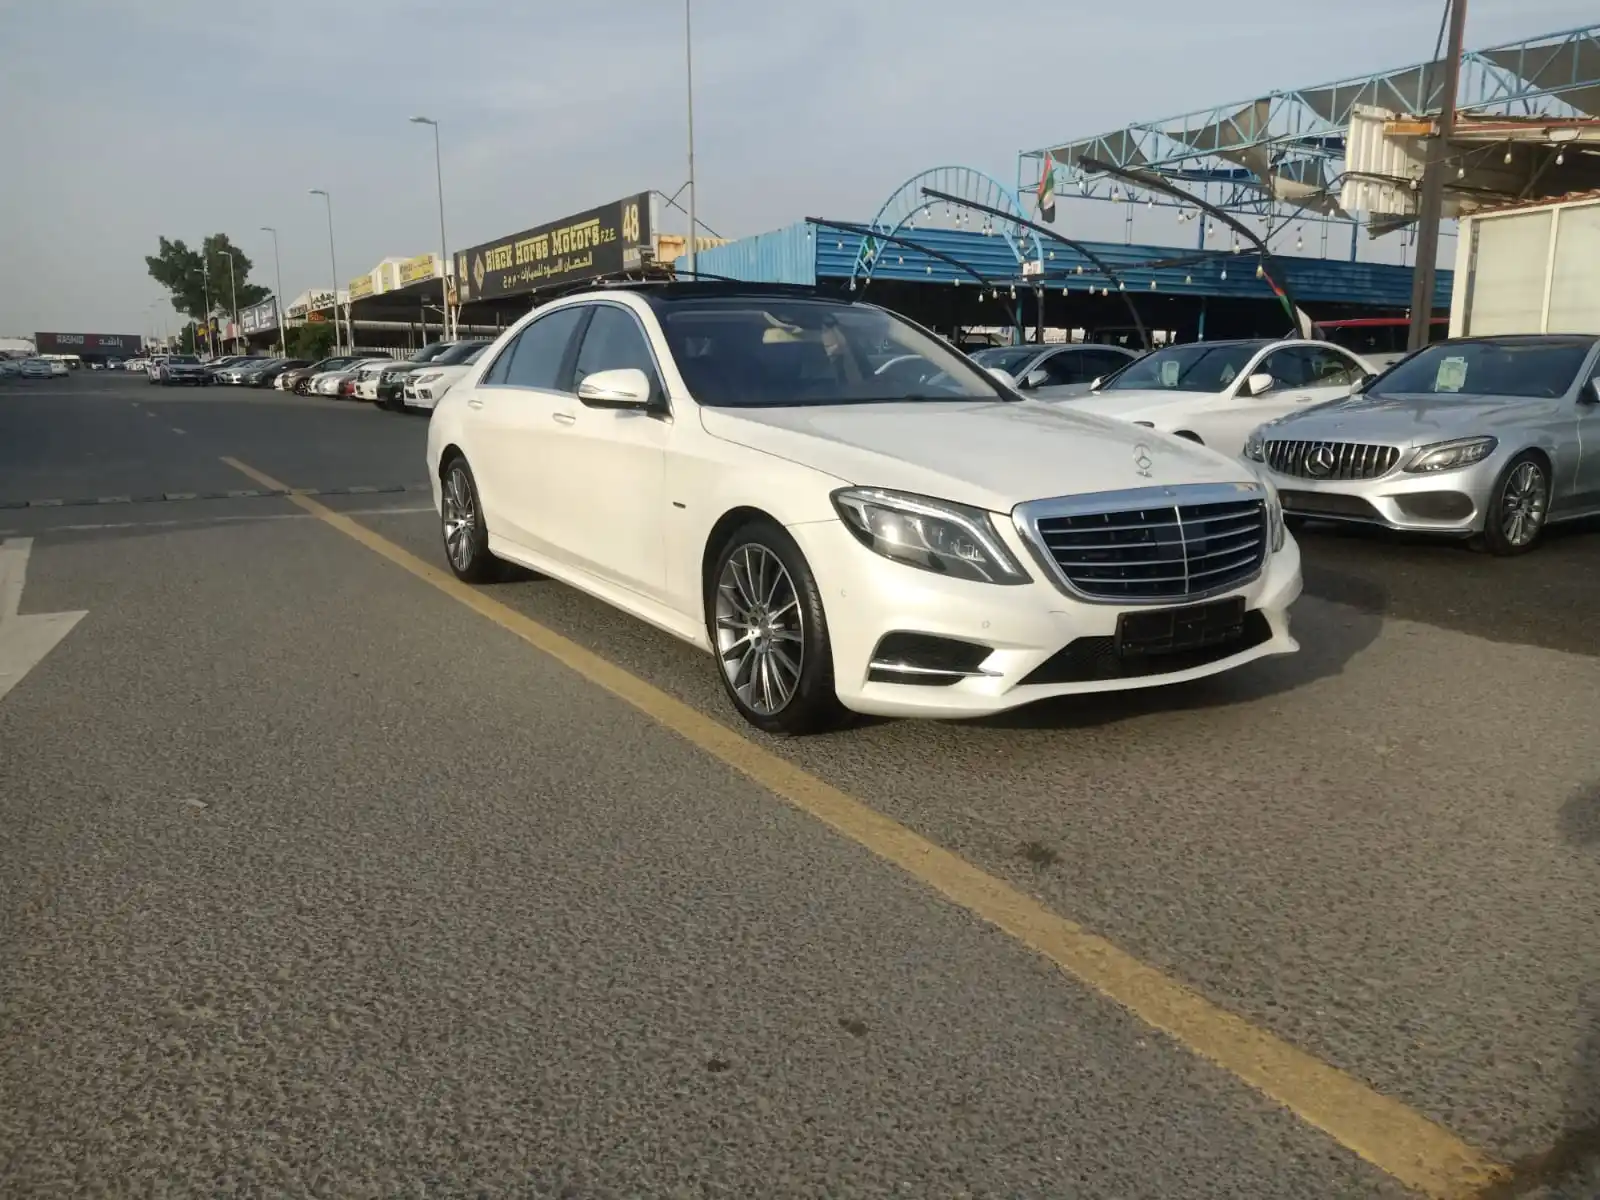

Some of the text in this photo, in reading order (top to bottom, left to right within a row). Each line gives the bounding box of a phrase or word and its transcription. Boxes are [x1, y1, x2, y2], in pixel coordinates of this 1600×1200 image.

[485, 245, 512, 272] Black
[514, 233, 548, 265] Horse
[551, 218, 600, 256] Motors
[623, 203, 639, 243] 48
